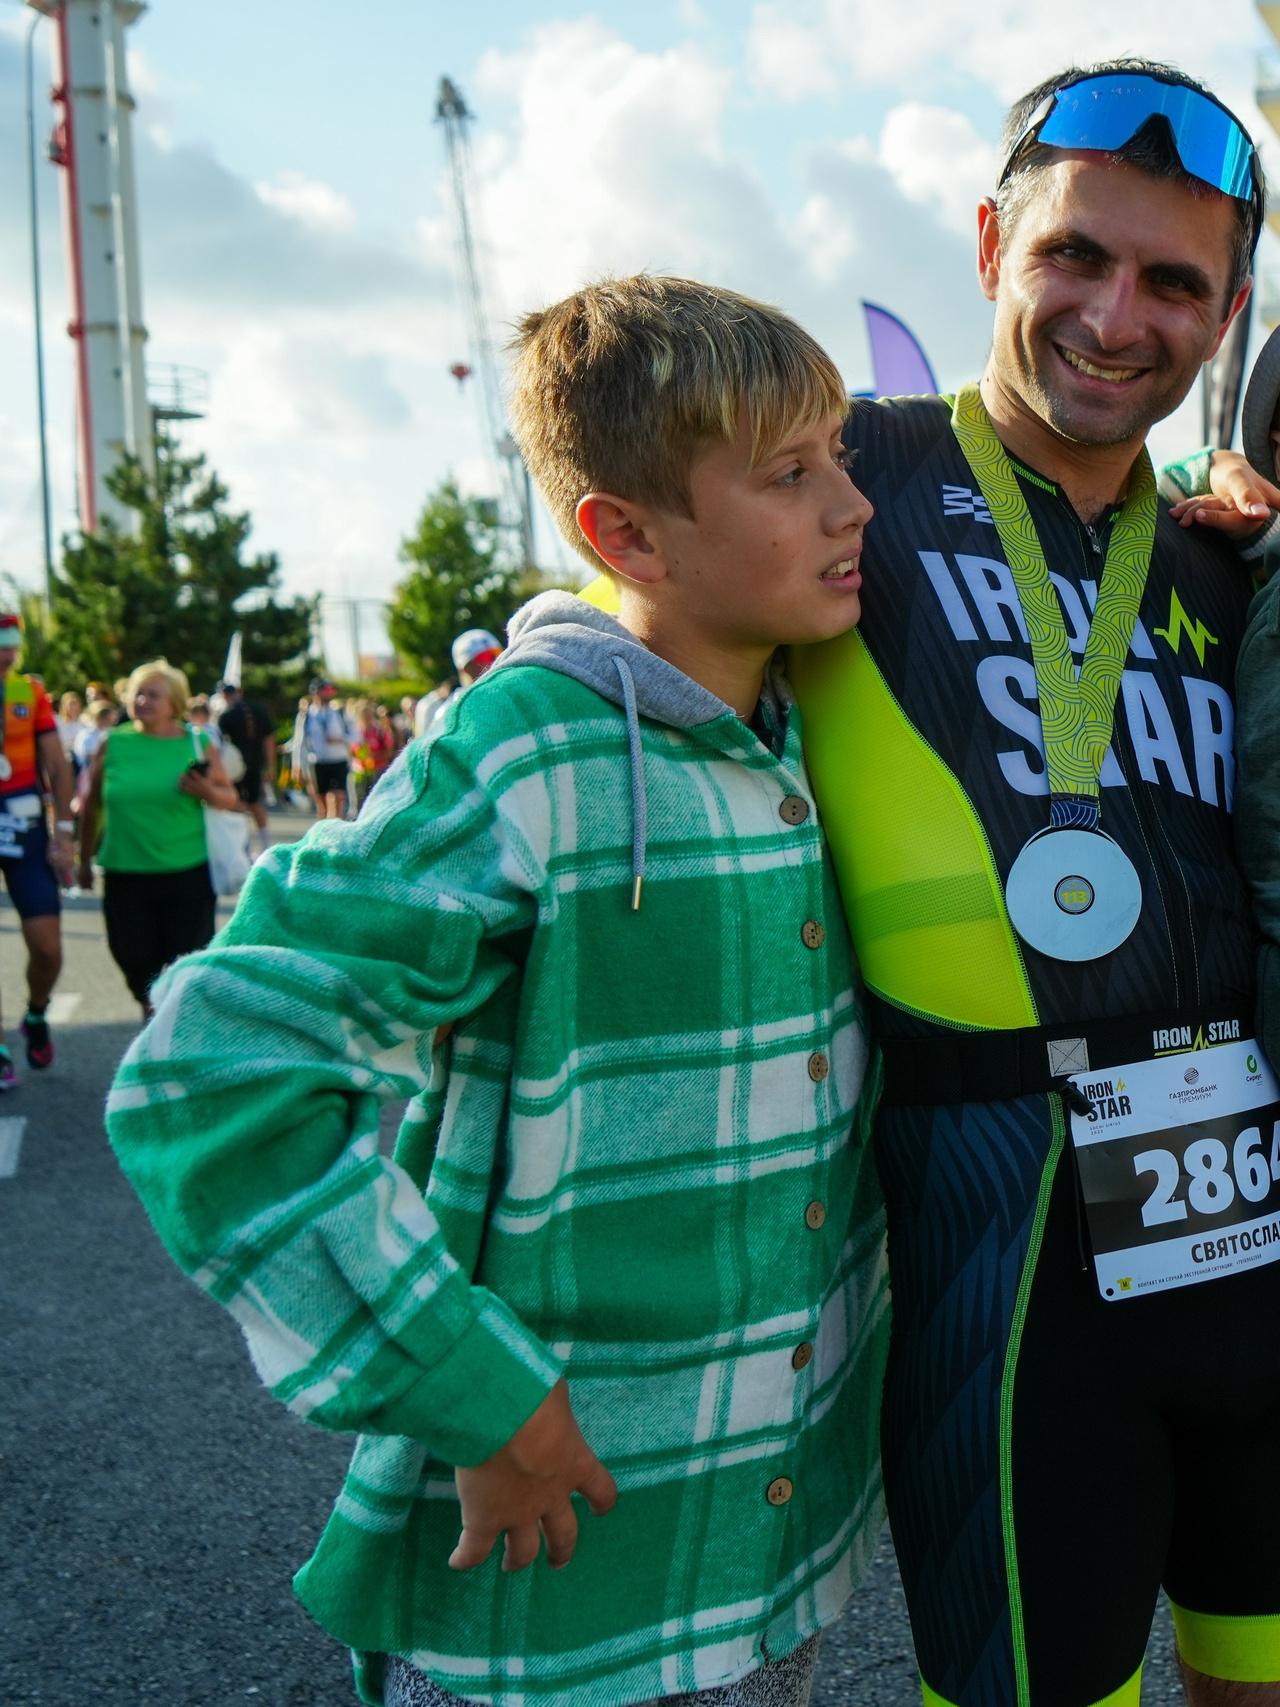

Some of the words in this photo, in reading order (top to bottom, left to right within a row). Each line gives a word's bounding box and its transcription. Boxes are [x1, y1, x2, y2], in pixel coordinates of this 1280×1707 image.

[976, 655, 1235, 815] SAR
[1062, 890, 1087, 904] 113
[1152, 1026, 1192, 1049] IRON
[1208, 1019, 1240, 1041] STAR
[1083, 1080, 1114, 1100] IRON
[1169, 1084, 1218, 1100] ГАЗПРОМБАНК
[1178, 1092, 1212, 1104] ПРЕМИУМ
[1087, 1095, 1132, 1122] STAR
[1137, 1279, 1158, 1288] КОНТАКТ
